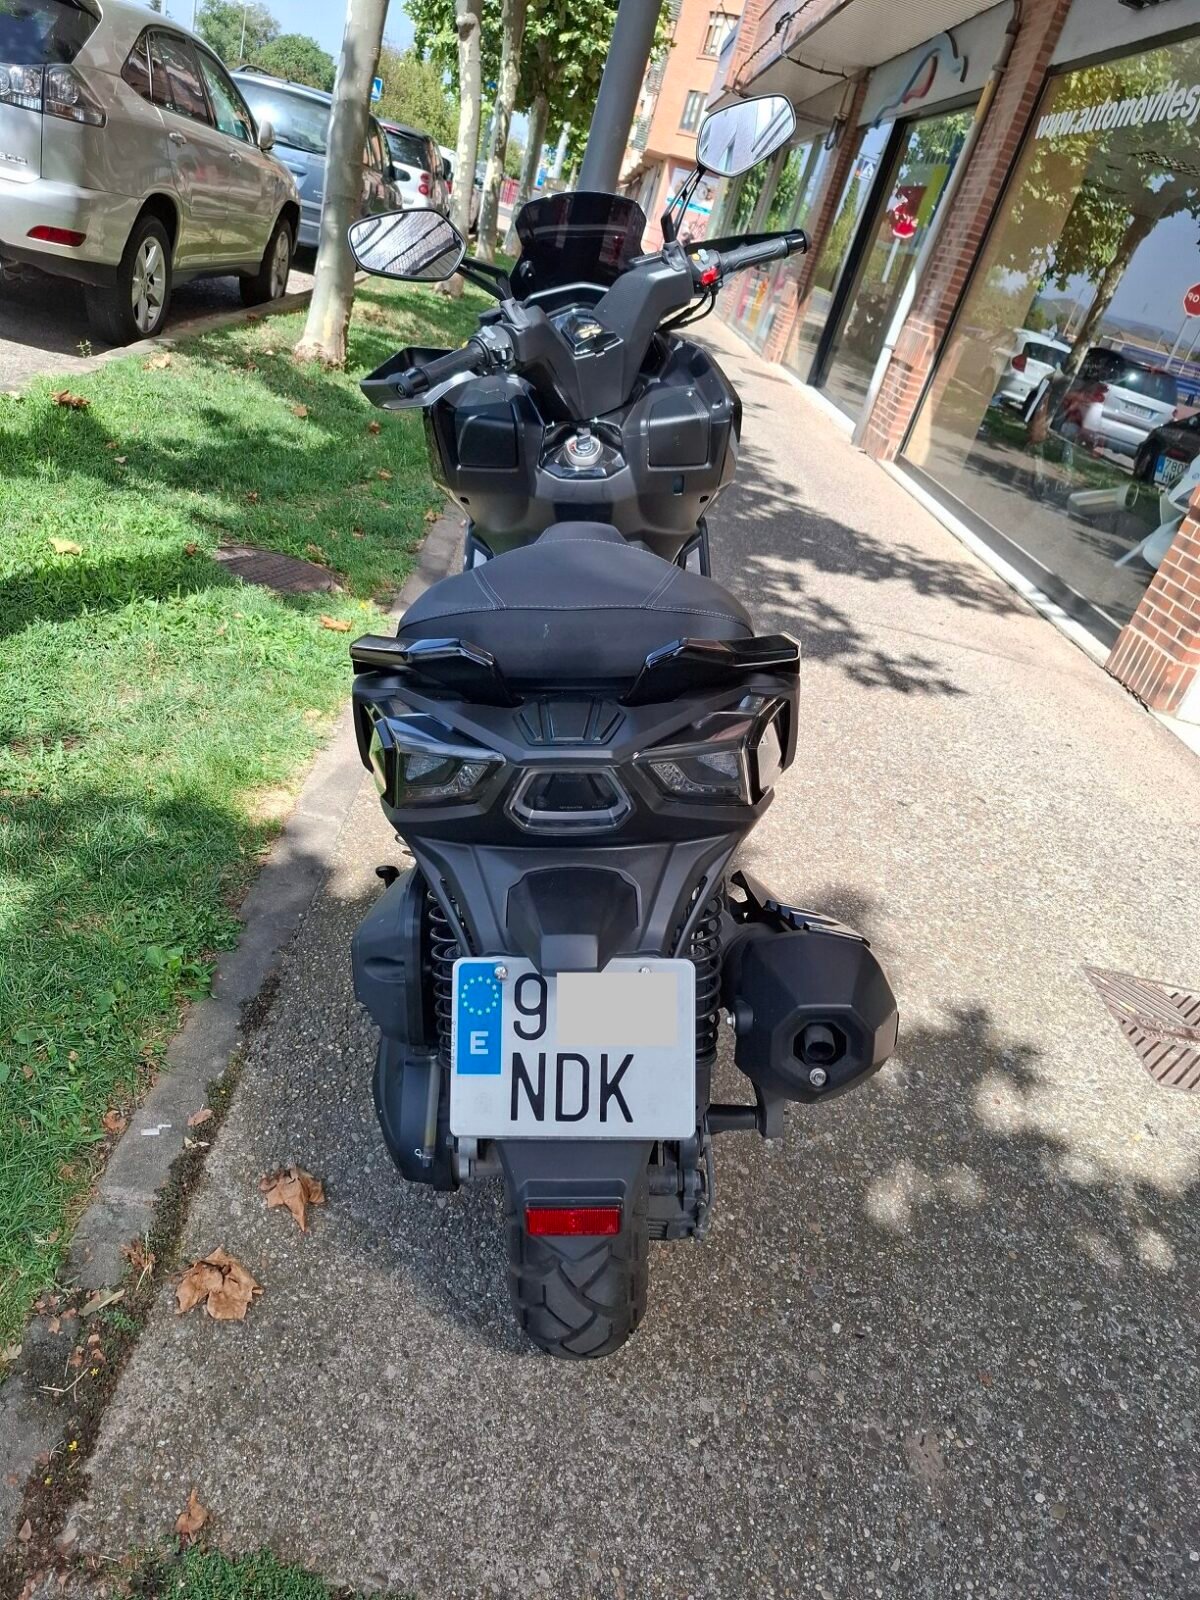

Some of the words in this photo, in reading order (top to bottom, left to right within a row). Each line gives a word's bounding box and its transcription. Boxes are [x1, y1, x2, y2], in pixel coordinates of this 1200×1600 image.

[1165, 459, 1187, 474] 780
[469, 1030, 489, 1055] E
[510, 1052, 634, 1123] NDK
